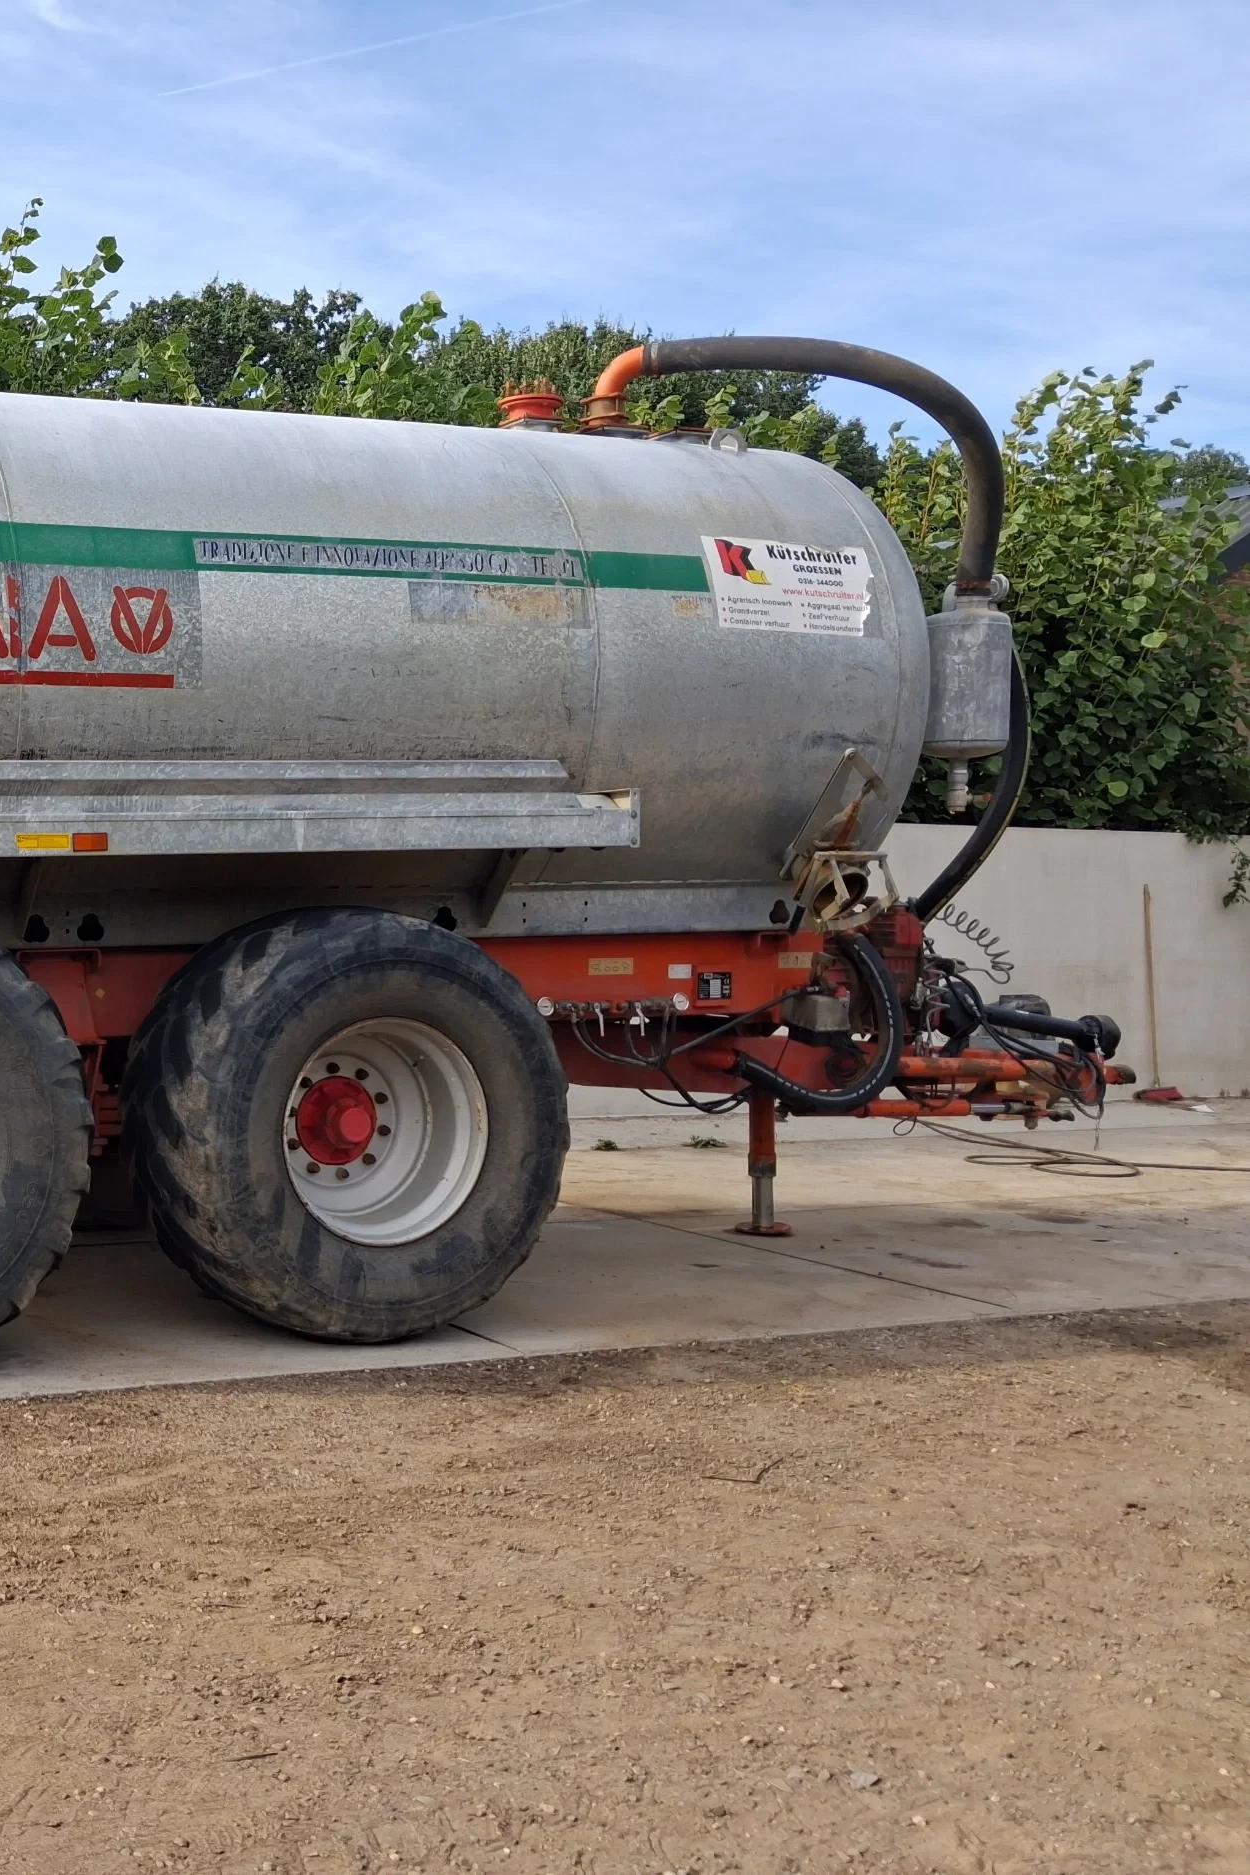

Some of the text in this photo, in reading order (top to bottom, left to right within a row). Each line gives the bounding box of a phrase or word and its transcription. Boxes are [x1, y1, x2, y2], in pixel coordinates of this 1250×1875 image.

[765, 544, 857, 566] Kütschruiter
[792, 563, 842, 576] GROESSEN
[782, 588, 864, 601] www.kutschruiter.nl
[727, 596, 793, 607] Agrarisch loonwerk
[729, 617, 791, 628] Container verhuur
